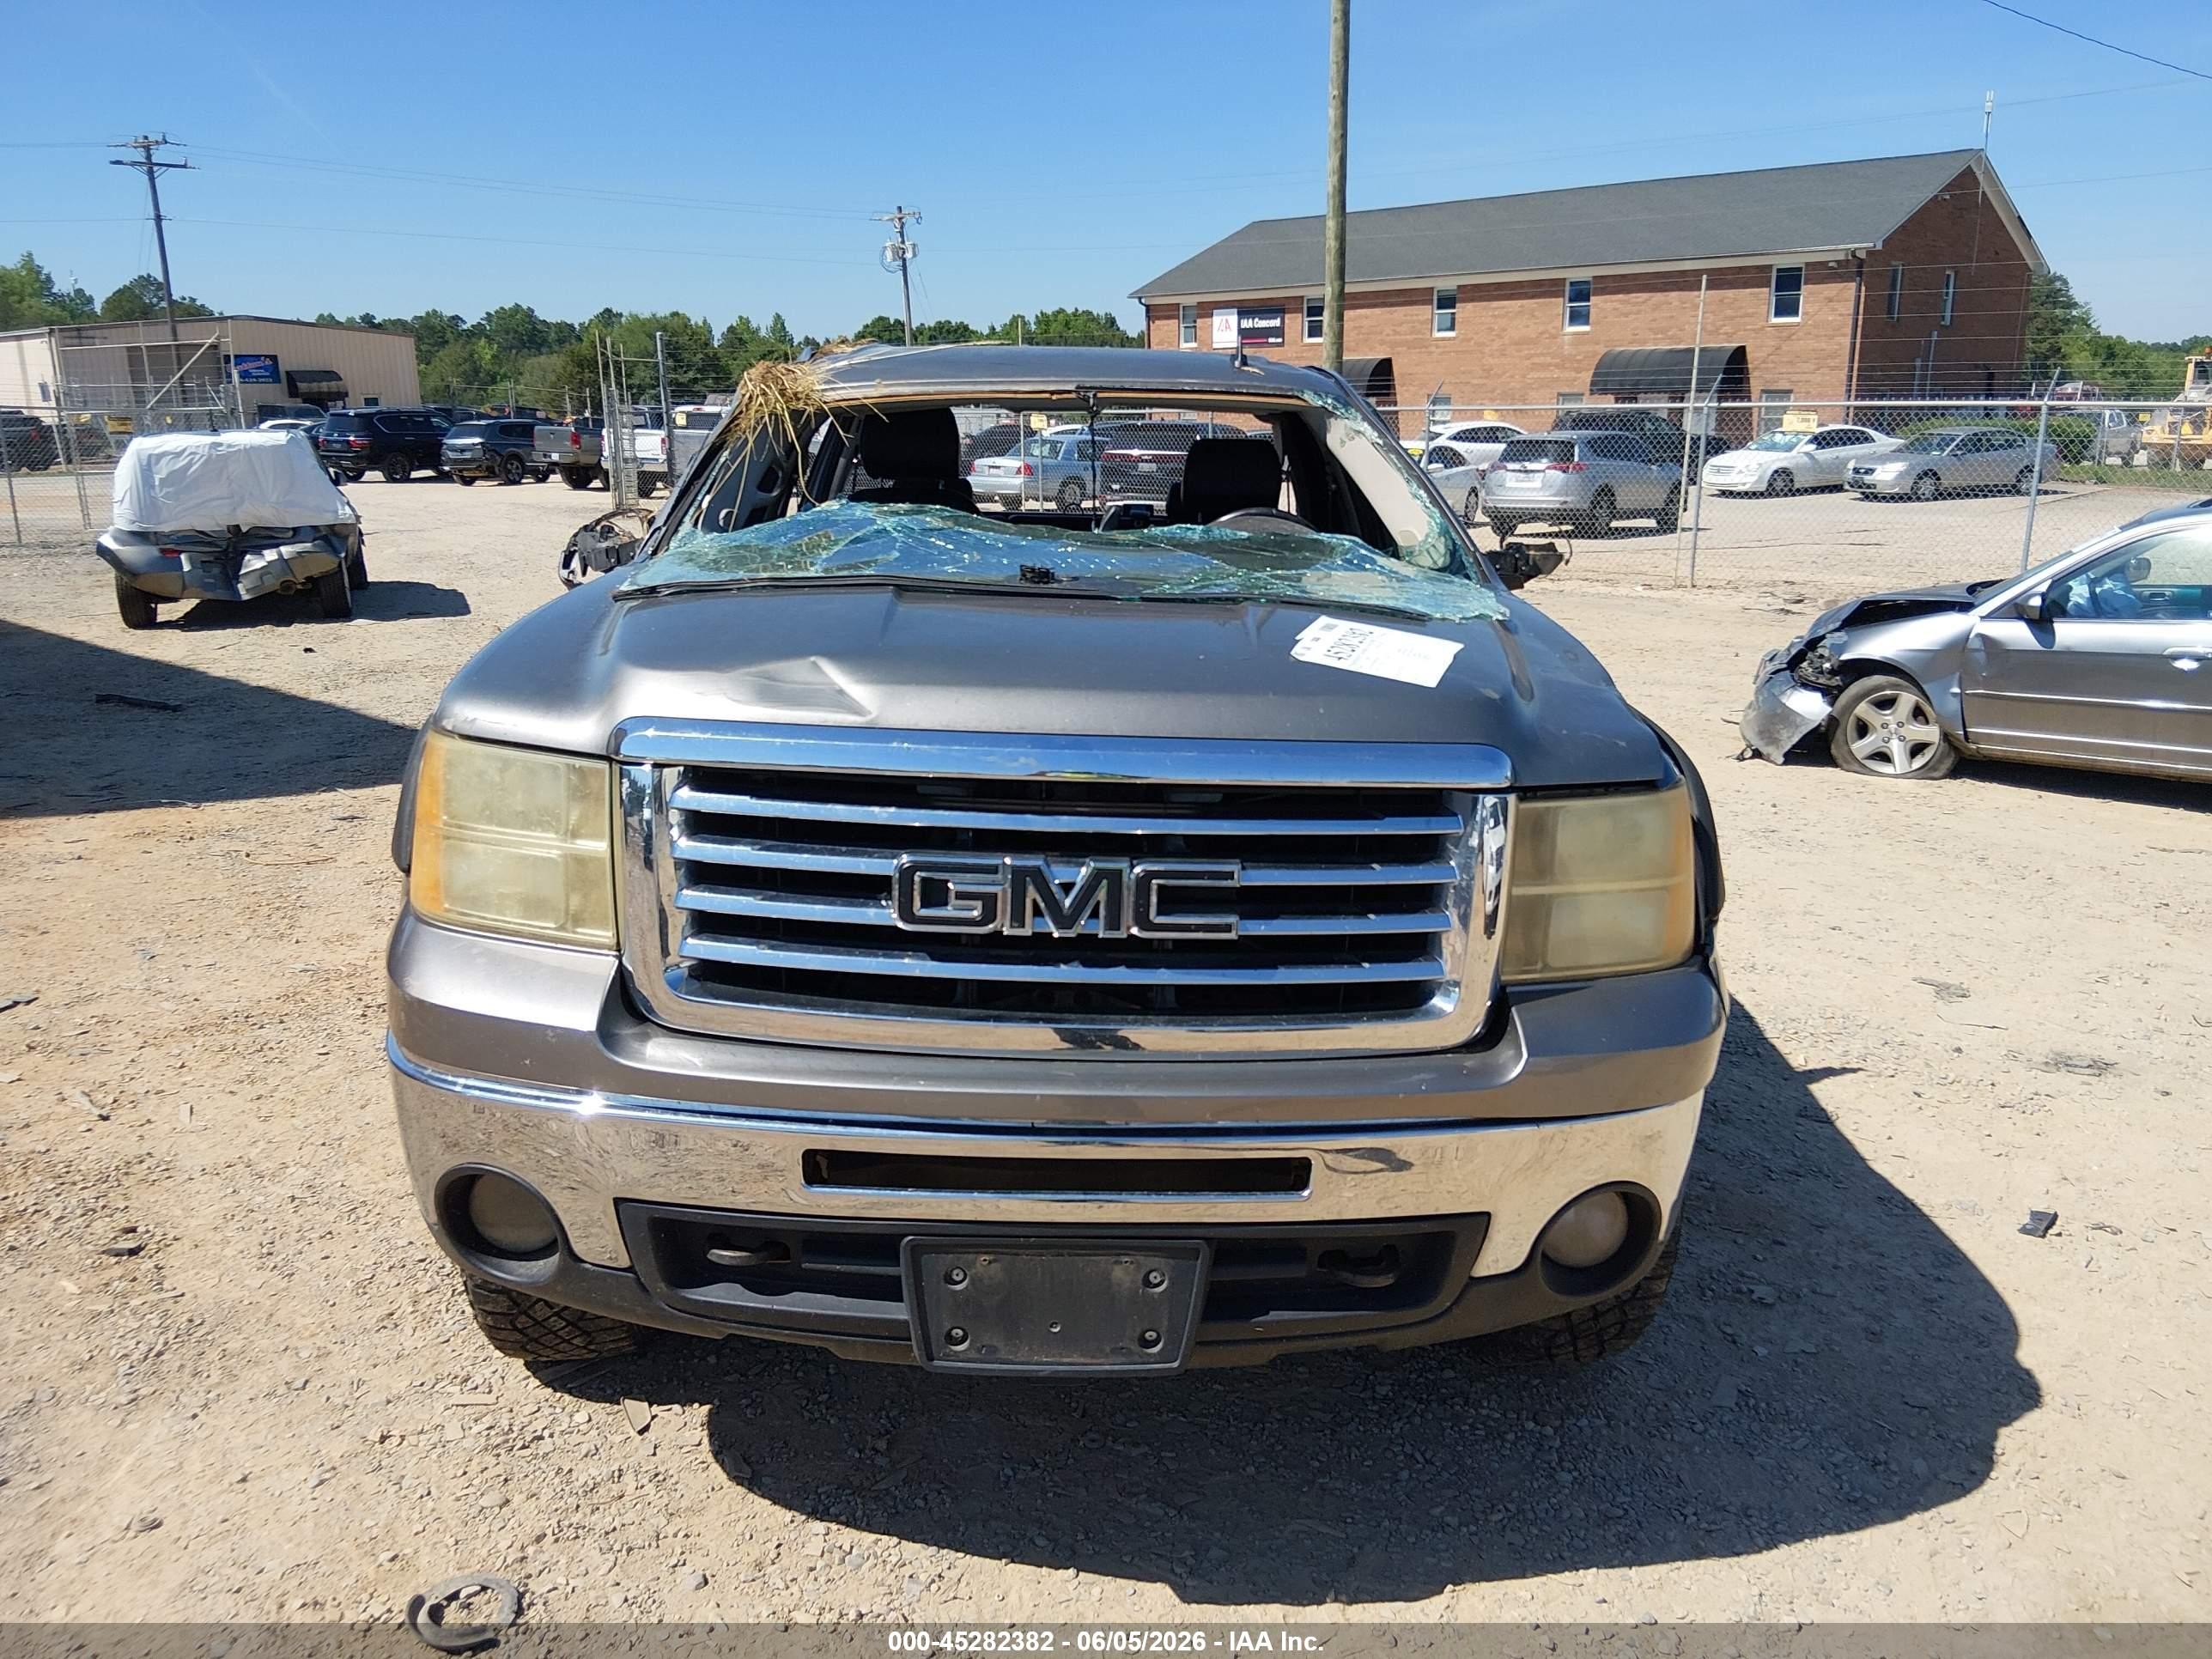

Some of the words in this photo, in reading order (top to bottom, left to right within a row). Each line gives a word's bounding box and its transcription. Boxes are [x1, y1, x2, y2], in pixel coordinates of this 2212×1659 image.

[1240, 318, 1254, 329] IAA
[1254, 317, 1281, 328] Concord
[892, 852, 1242, 939] GMC
